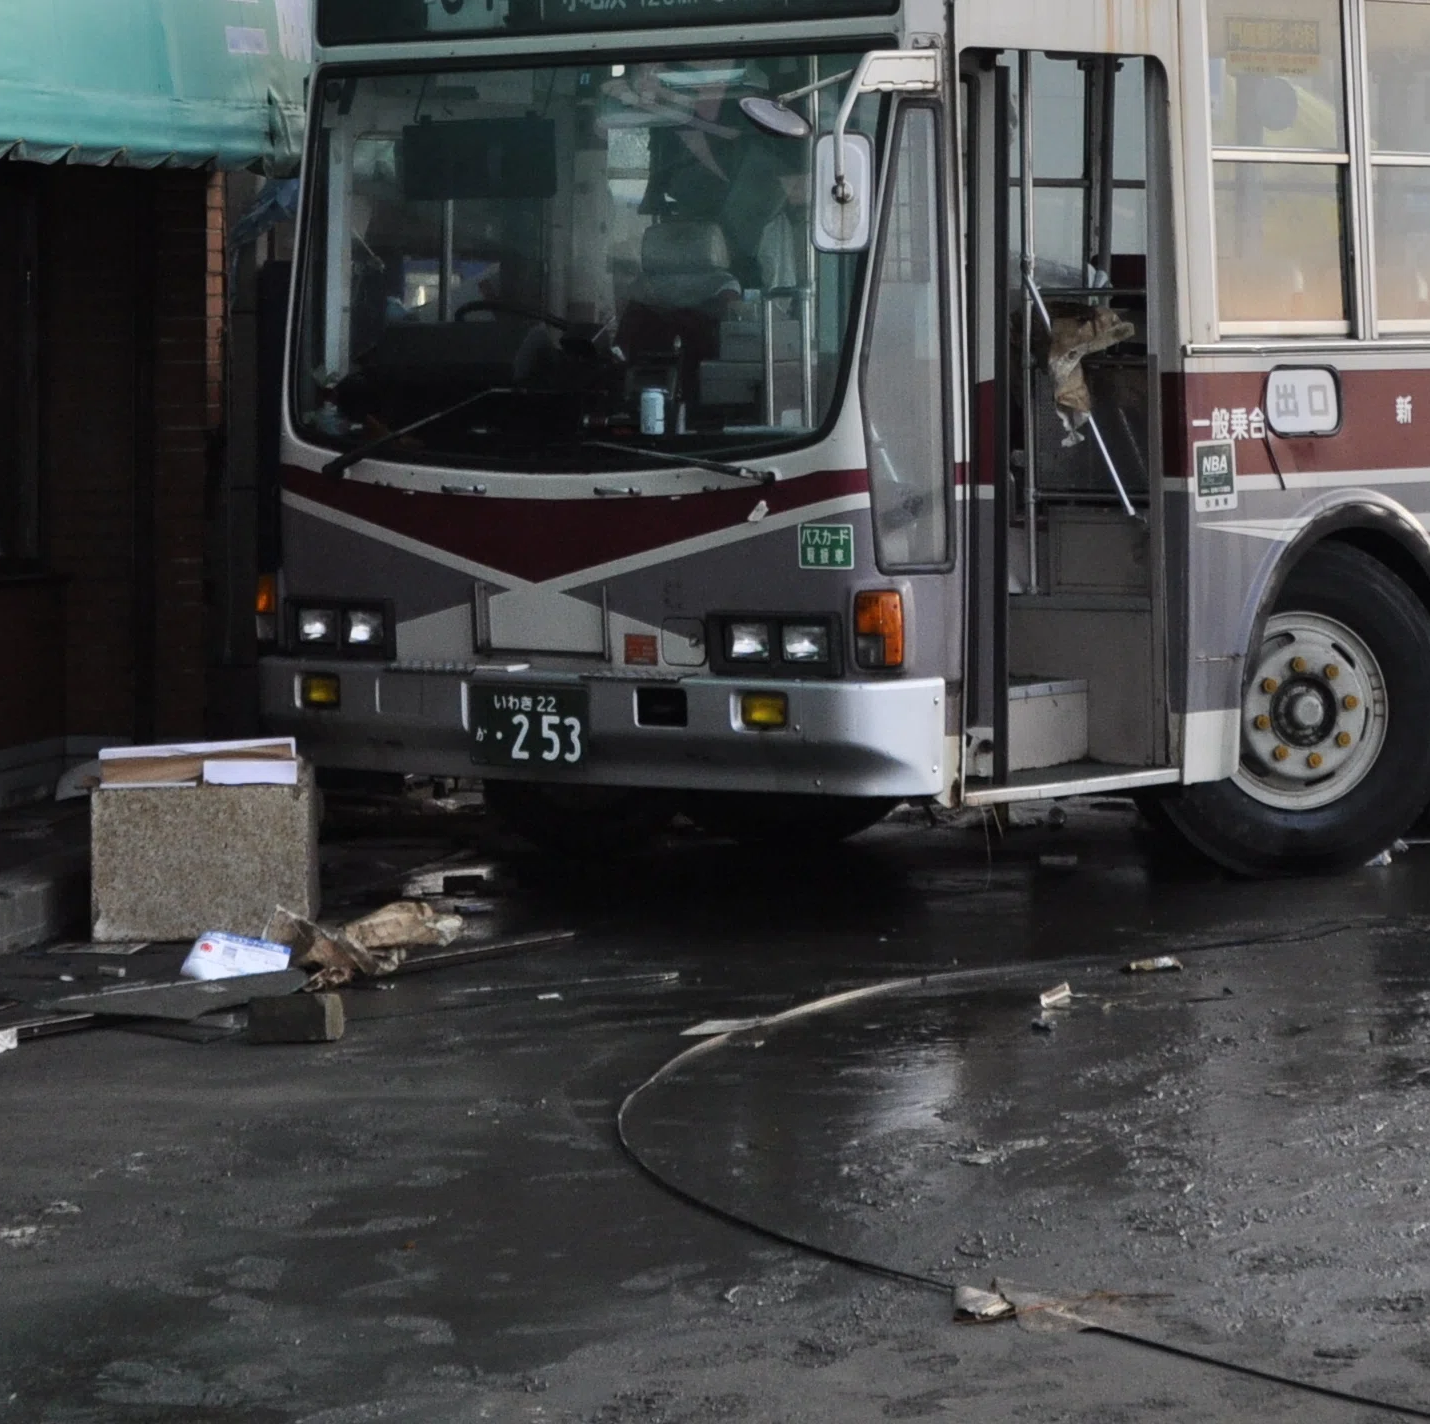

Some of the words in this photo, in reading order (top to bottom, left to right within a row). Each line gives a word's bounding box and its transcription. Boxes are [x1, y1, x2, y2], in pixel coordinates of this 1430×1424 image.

[1275, 383, 1329, 418] 出口
[1192, 407, 1266, 440] 一般乗合
[1202, 454, 1229, 476] NBA
[801, 528, 850, 546] バスカード
[493, 695, 533, 712] いわき
[536, 696, 557, 713] 22
